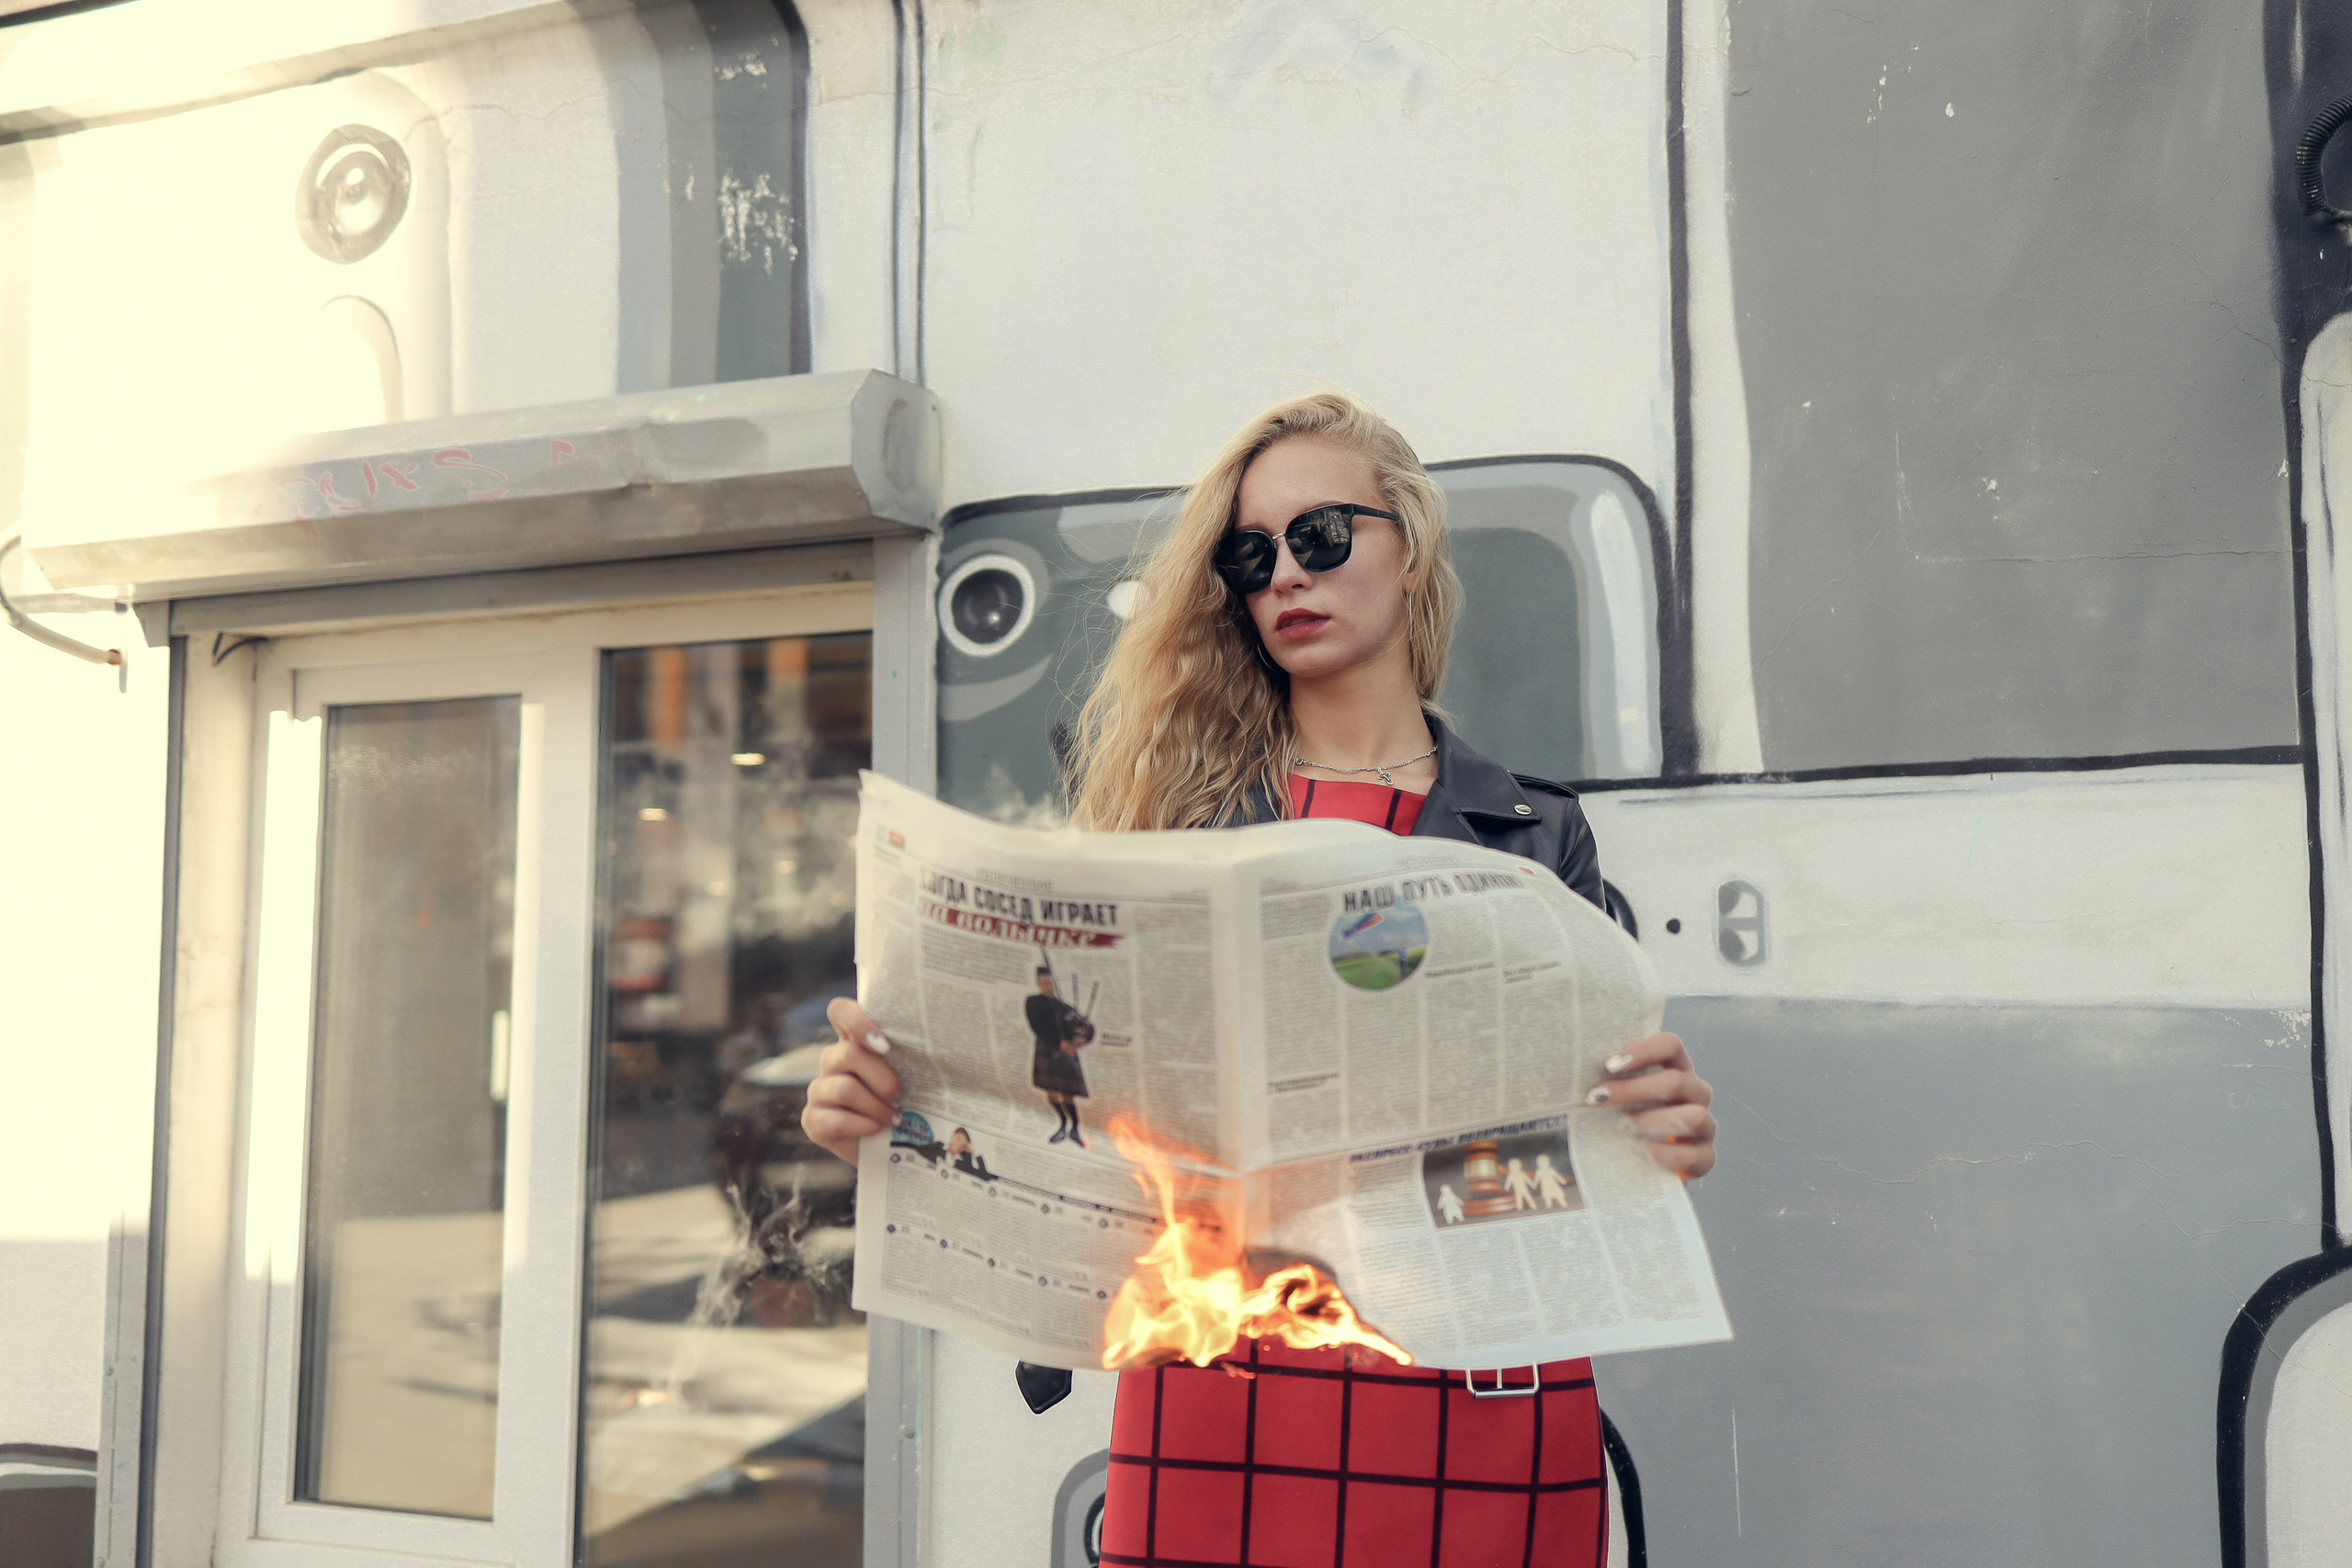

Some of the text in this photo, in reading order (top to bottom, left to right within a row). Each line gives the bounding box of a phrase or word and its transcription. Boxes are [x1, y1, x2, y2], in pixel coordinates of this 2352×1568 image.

[974, 886, 1034, 923] СОСЕД
[1041, 900, 1118, 927] ИГРАЕТ
[1344, 885, 1395, 912] НАШ
[1401, 874, 1453, 904] ПУТЬ
